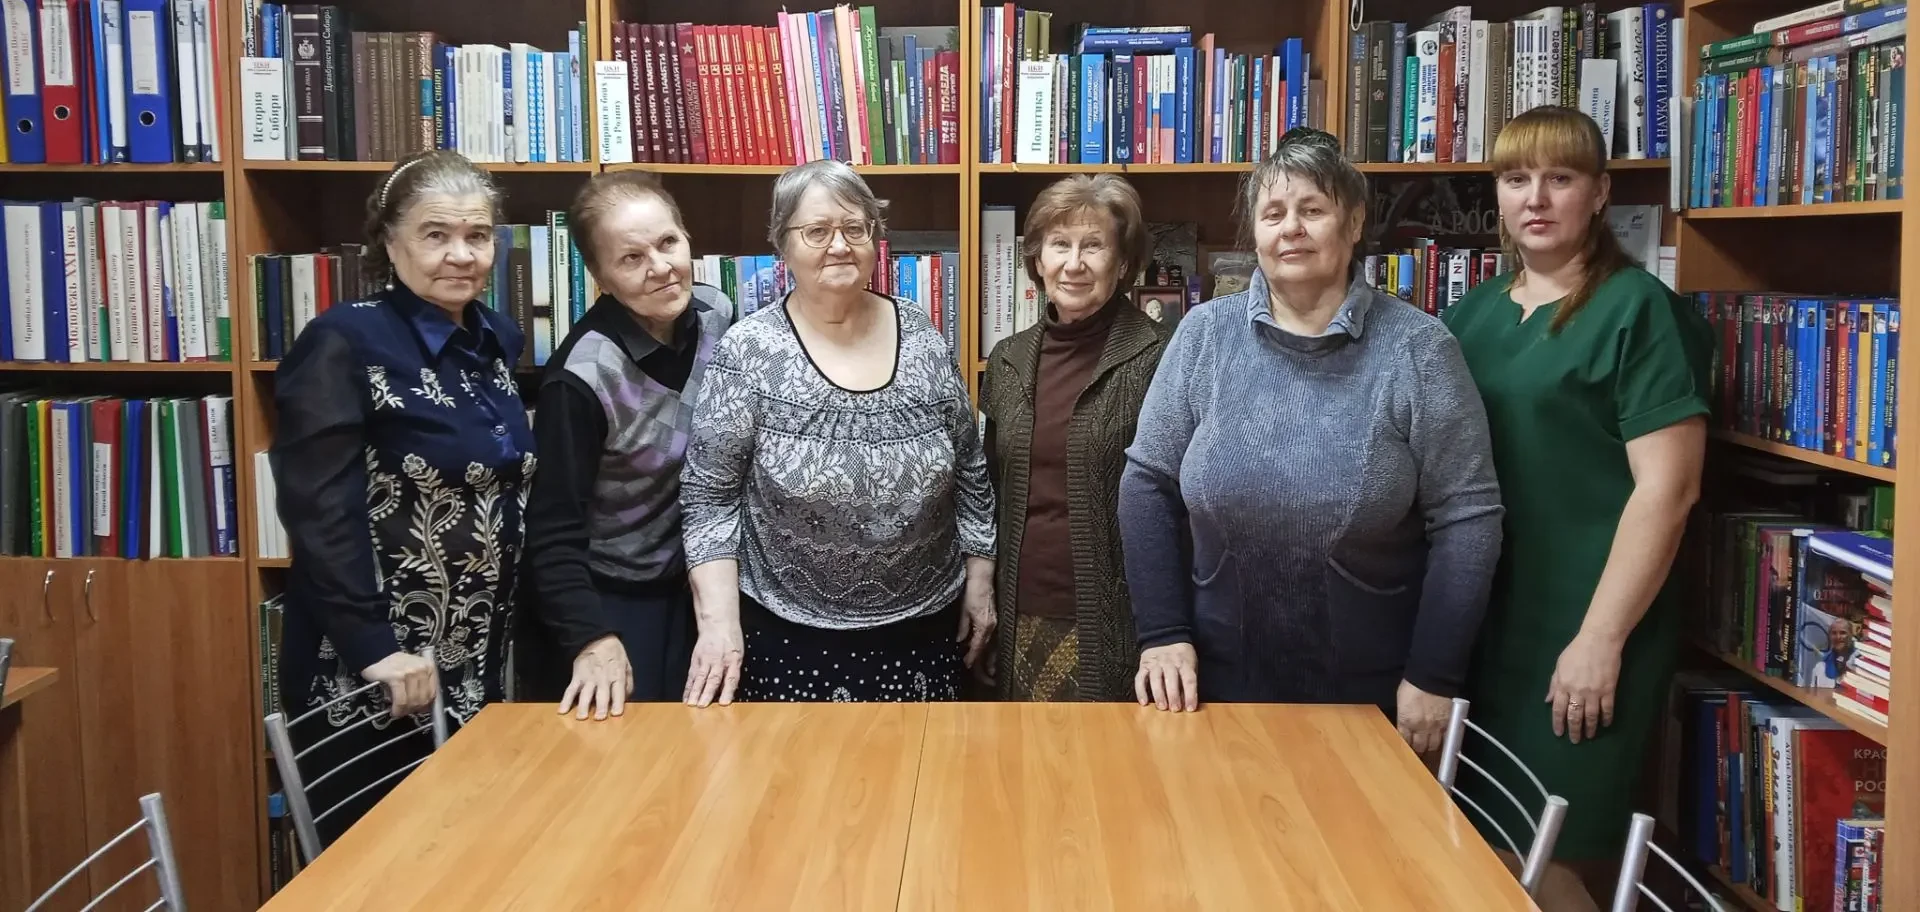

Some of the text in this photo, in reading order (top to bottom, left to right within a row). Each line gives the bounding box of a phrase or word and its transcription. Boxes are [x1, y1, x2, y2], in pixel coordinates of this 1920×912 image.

[322, 8, 333, 38] Сибирь
[324, 44, 334, 93] Декабристы
[1353, 65, 1362, 86] ДЕТЕЙ
[1549, 30, 1560, 100] ЧУДЕСА света
[1633, 28, 1644, 84] Космос
[1654, 21, 1667, 81] ТЕХНИКА
[433, 68, 444, 144] ИСТОРИЯ СИБИРИ
[598, 83, 609, 104] боях
[630, 50, 643, 126] КНИГА ПАМЯТИ
[645, 50, 659, 126] КНИГА ПАМЯТИ
[659, 53, 674, 129] КНИГА ПАМЯТИ
[671, 54, 687, 130] КНИГА ПАМЯТИ
[940, 64, 951, 113] ПОБЕДА
[253, 92, 267, 144] История
[269, 95, 281, 141] Сибири
[600, 114, 612, 162] Сибиряки
[612, 100, 623, 133] Родину
[941, 120, 950, 144] 1945
[1031, 90, 1044, 152] Политика
[1353, 103, 1361, 156] ЭНЦИКЛОПЕДИЯ
[1602, 99, 1612, 136] Космос
[1656, 95, 1668, 138] НАУКА
[1889, 128, 1898, 154] ВЕЛИКИХ
[64, 225, 80, 351] Молодежь XXI век
[110, 254, 120, 281] Родину
[125, 225, 140, 350] Летопись Великой Победы
[931, 267, 940, 290] Победы
[946, 265, 956, 295] живым
[982, 254, 990, 316] Смоктуновский
[993, 233, 1002, 333] Иннокентий Михайлович
[89, 310, 99, 346] История
[946, 296, 957, 321] нужна
[1786, 774, 1794, 801] МИРА
